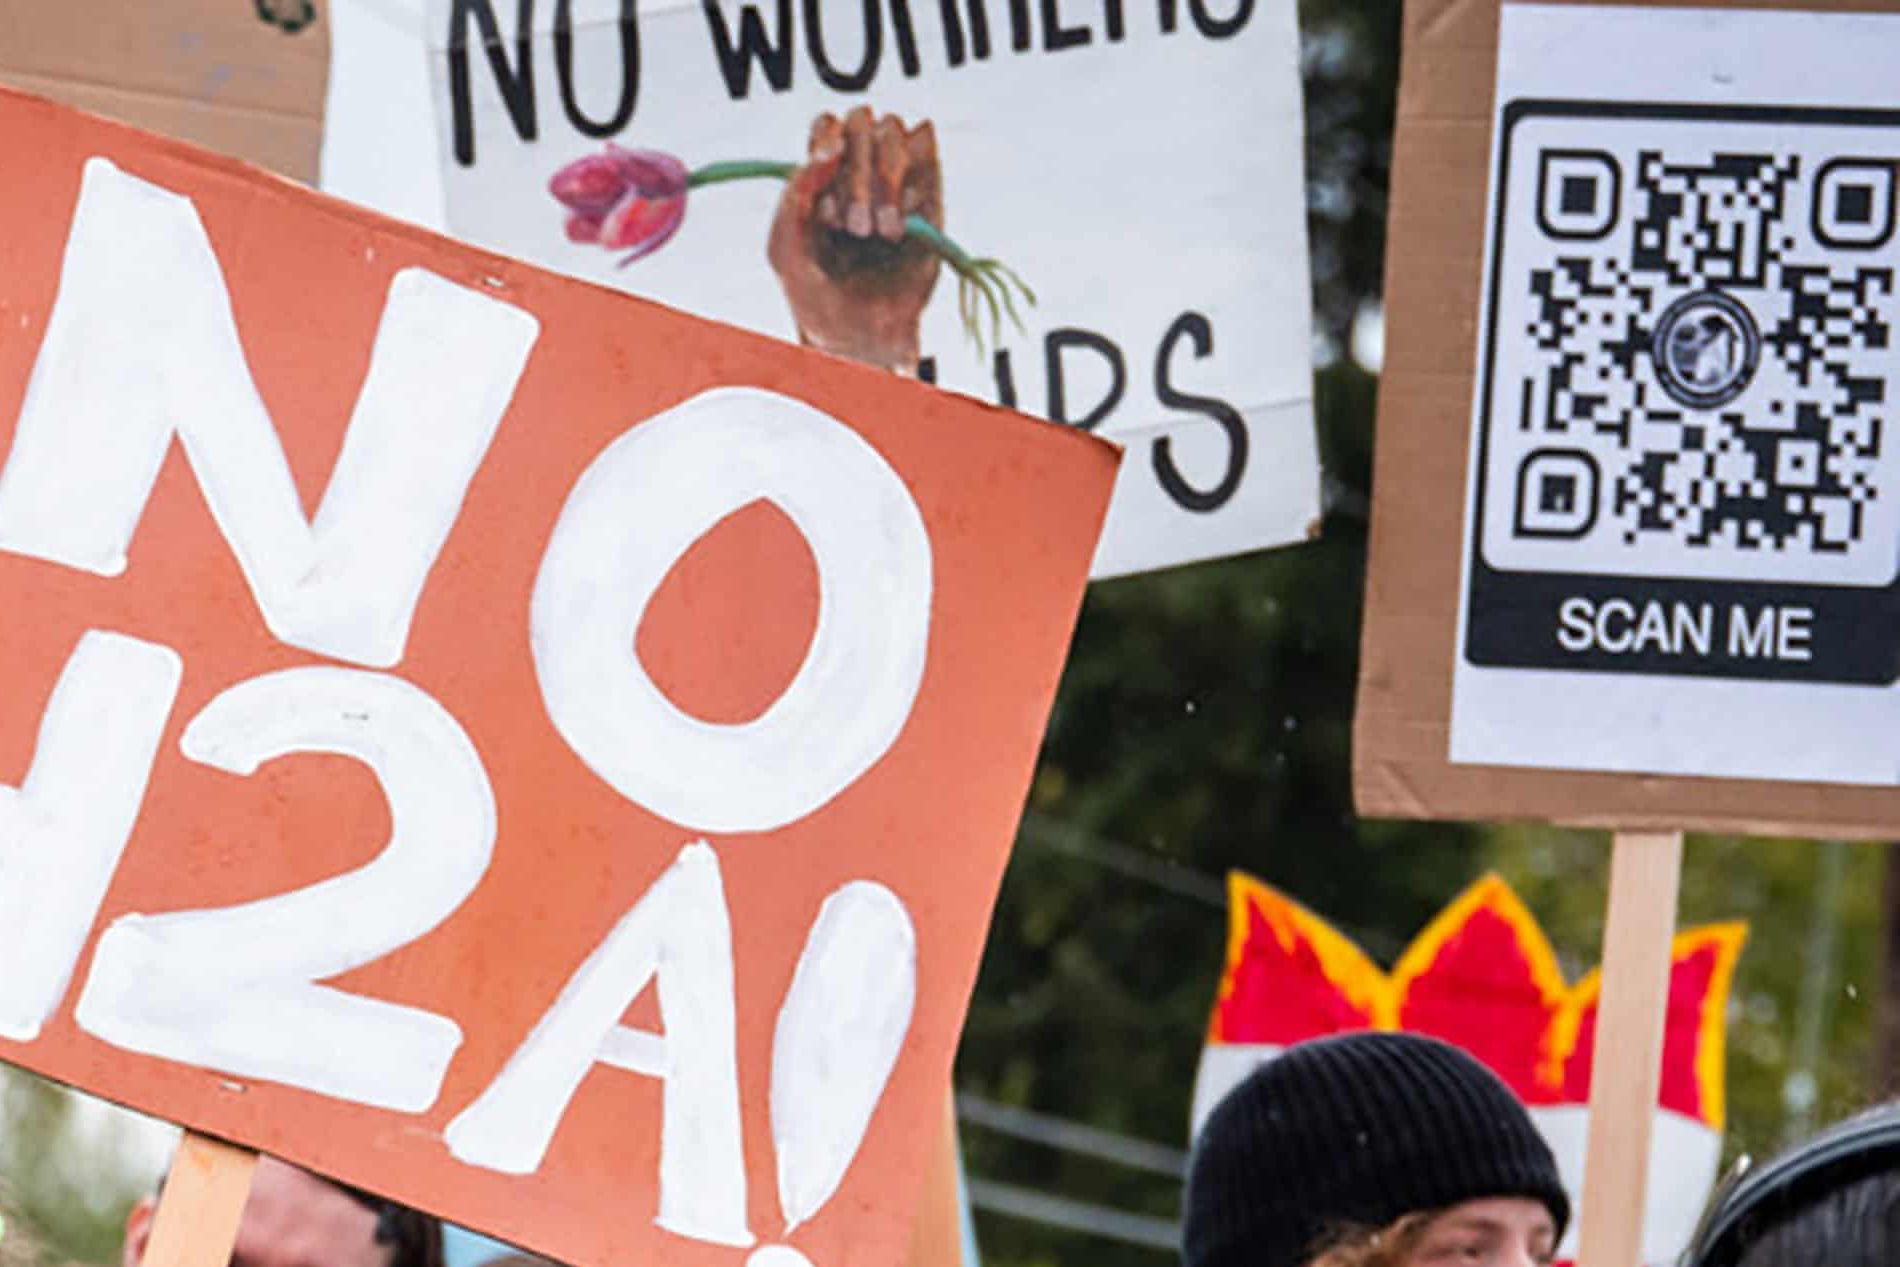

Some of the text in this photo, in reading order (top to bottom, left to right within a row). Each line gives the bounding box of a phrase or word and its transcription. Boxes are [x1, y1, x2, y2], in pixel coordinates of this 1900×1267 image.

[442, 0, 639, 166] NO
[1556, 597, 1814, 661] SCAN ME
